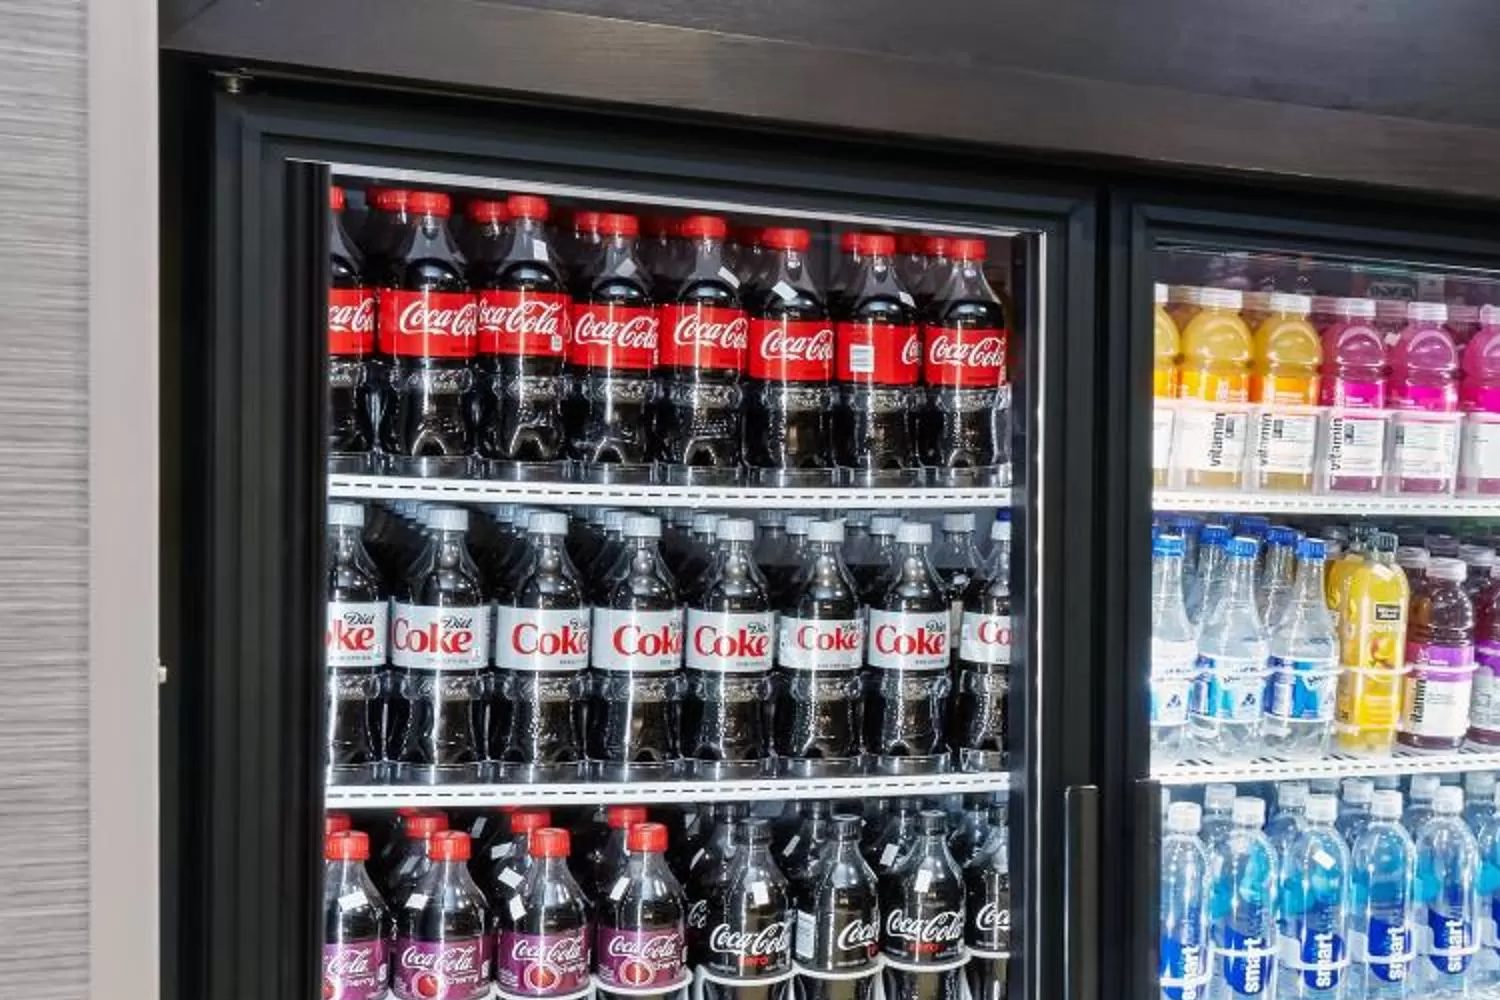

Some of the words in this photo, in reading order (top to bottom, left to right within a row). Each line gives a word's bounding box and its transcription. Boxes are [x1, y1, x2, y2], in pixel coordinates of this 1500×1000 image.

[343, 611, 375, 626] Diet
[440, 615, 473, 630] Diet
[392, 617, 473, 654] Coke
[694, 625, 770, 658] Coke
[797, 625, 859, 652] Coke
[875, 624, 946, 656] Coke
[977, 620, 1012, 645] Co
